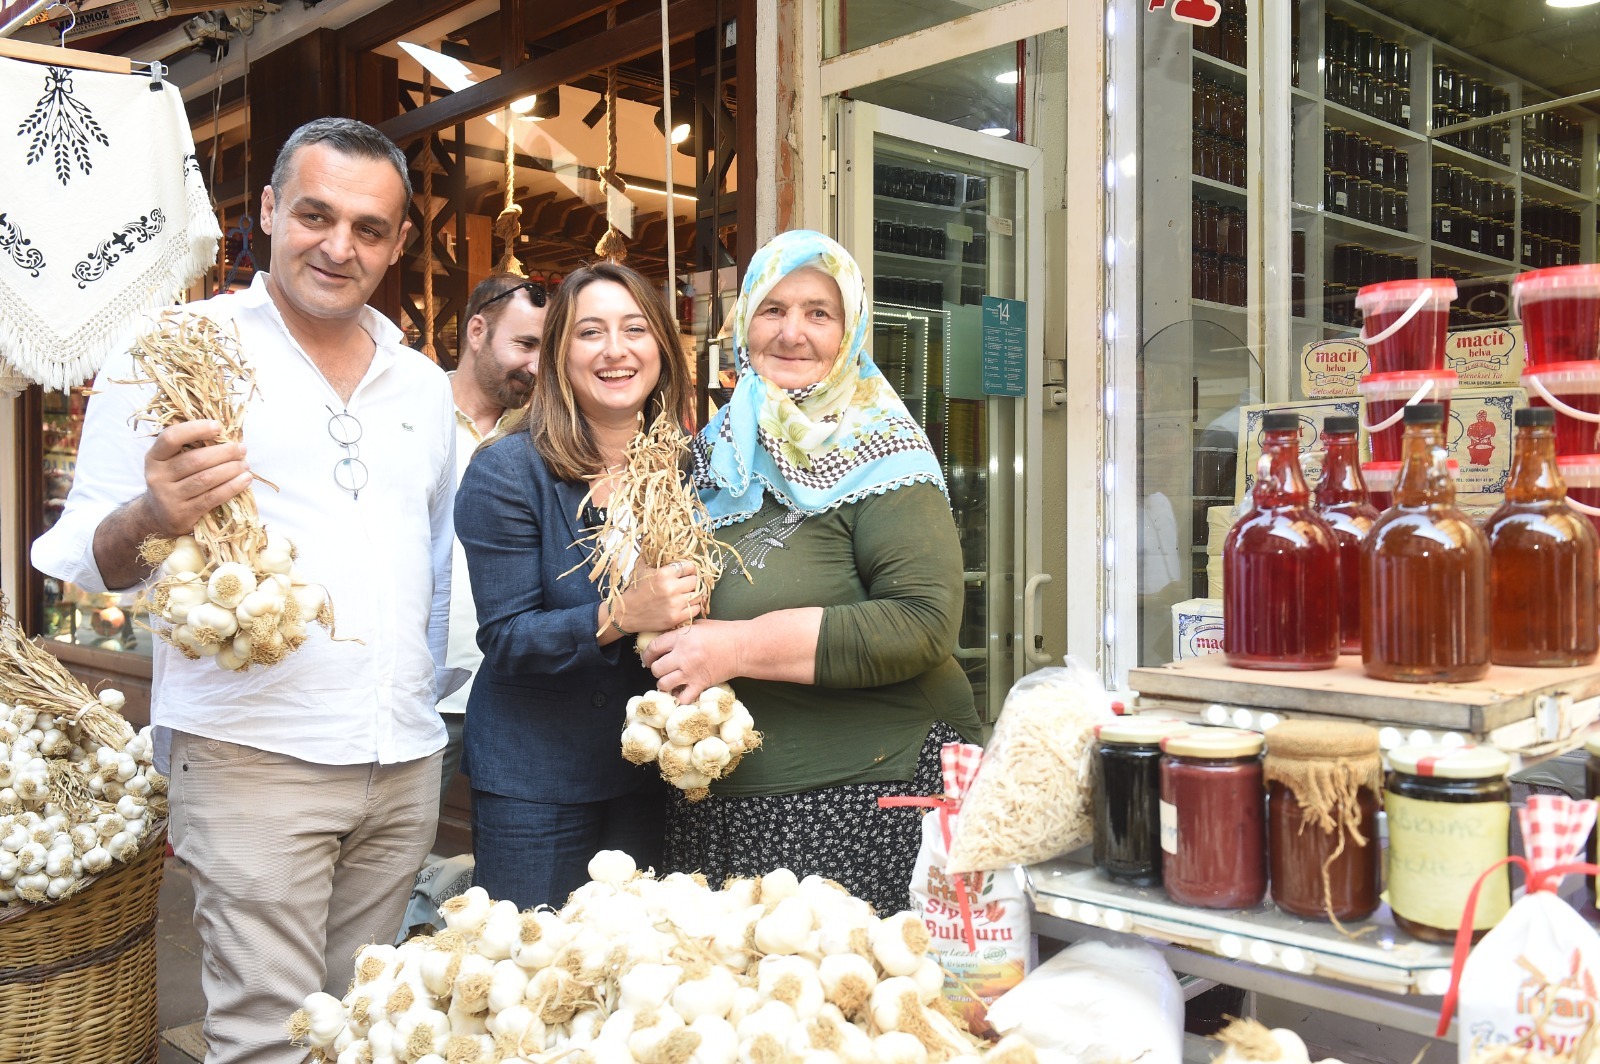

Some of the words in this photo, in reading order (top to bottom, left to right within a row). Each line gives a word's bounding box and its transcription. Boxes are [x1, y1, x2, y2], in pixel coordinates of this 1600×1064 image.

[997, 302, 1010, 321] 14
[1457, 331, 1504, 348] macit
[1315, 349, 1358, 363] macit
[1469, 348, 1491, 358] helva
[1326, 364, 1346, 372] helva
[925, 897, 985, 920] Siyz
